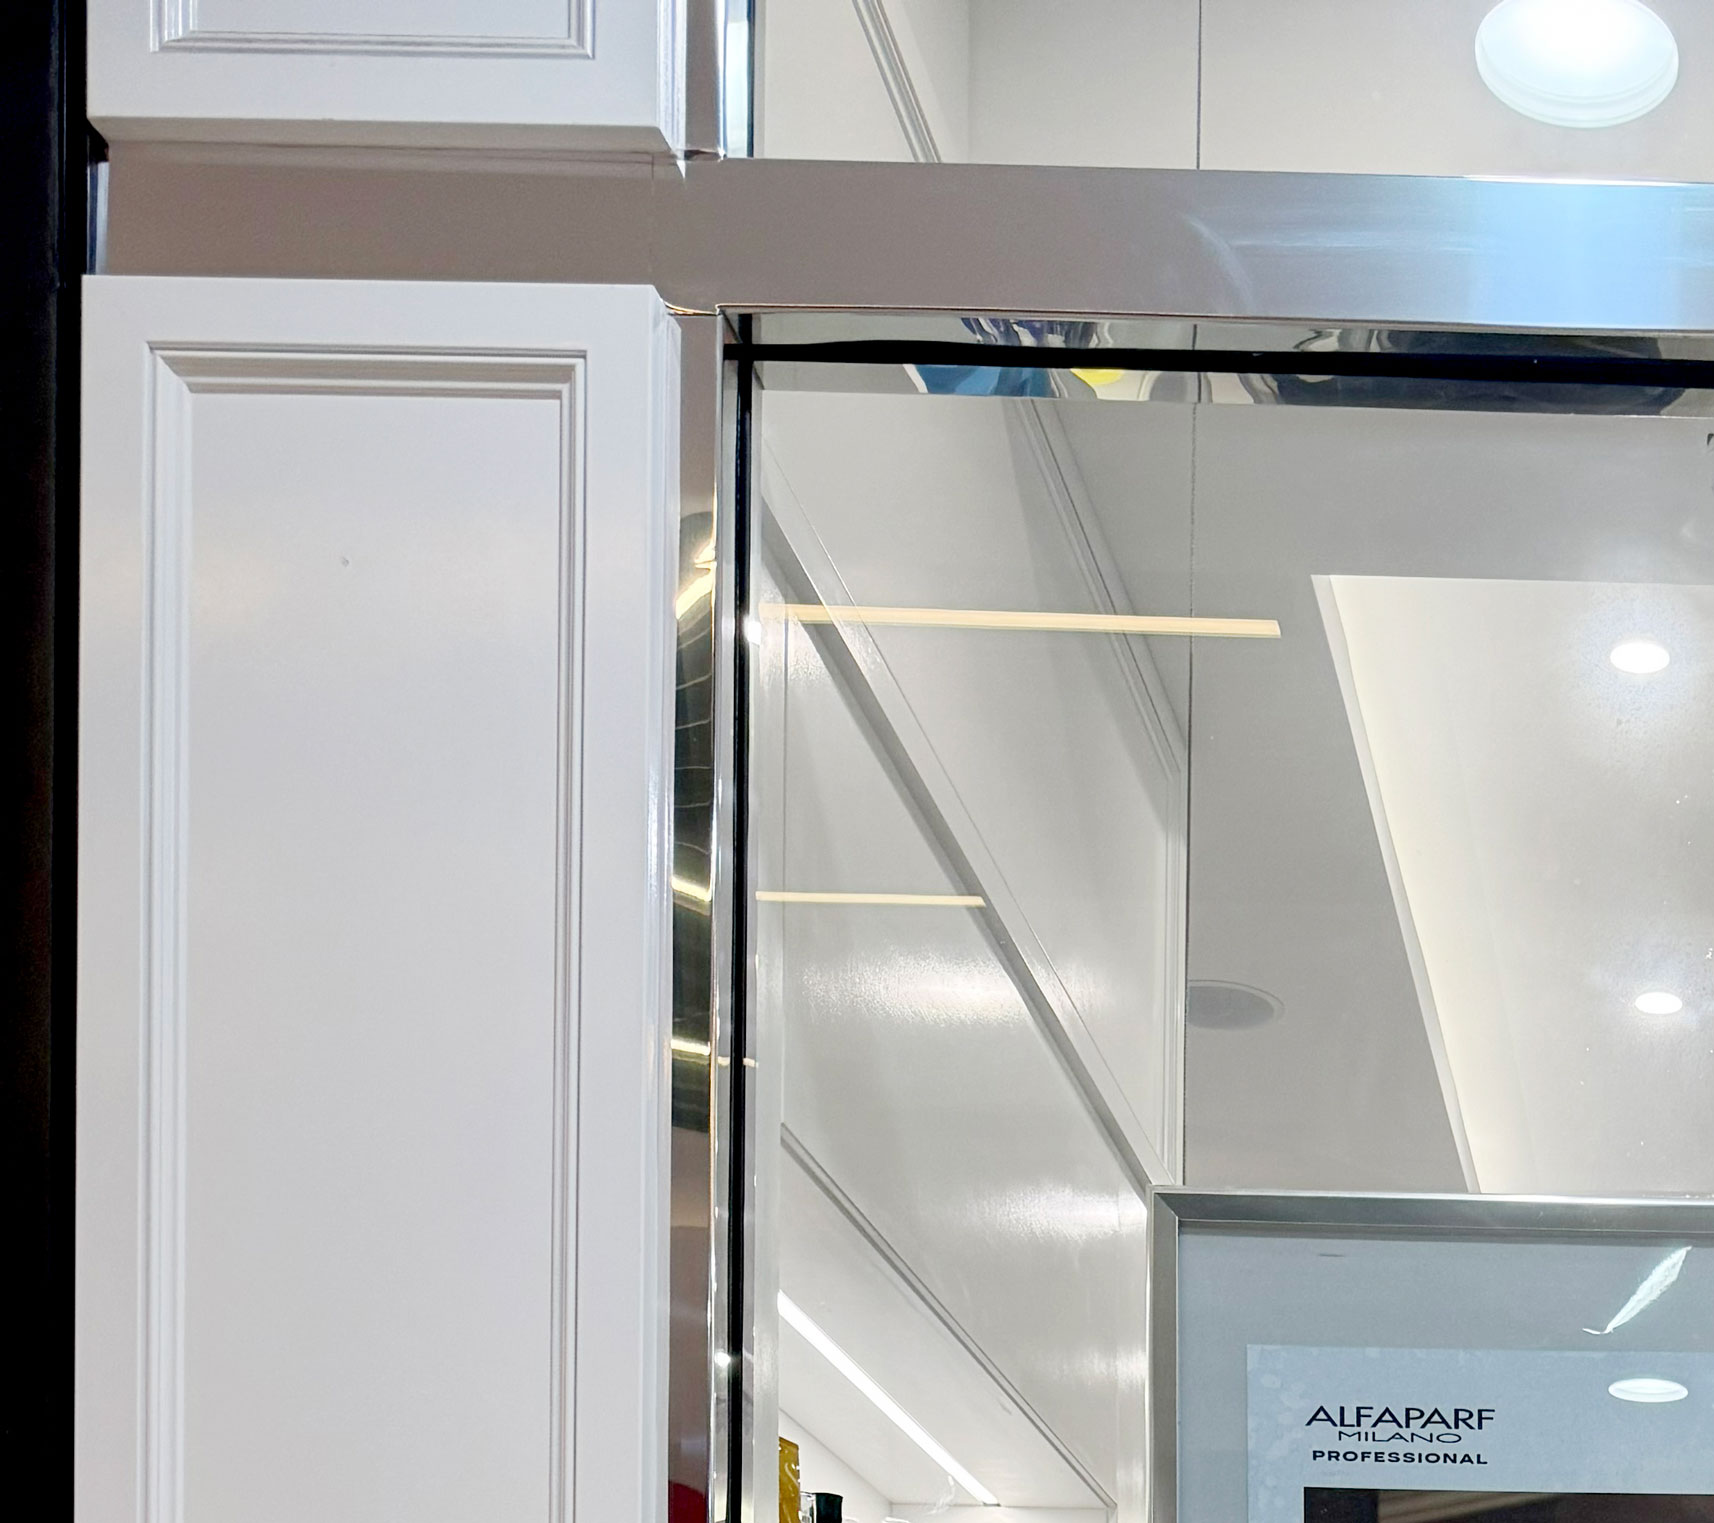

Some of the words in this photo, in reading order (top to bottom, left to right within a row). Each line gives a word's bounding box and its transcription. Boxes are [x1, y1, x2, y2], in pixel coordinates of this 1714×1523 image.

[1305, 1405, 1496, 1431] ALFAPARF
[1338, 1430, 1462, 1444] MILANO
[1312, 1450, 1488, 1465] PROFESSIONAL
